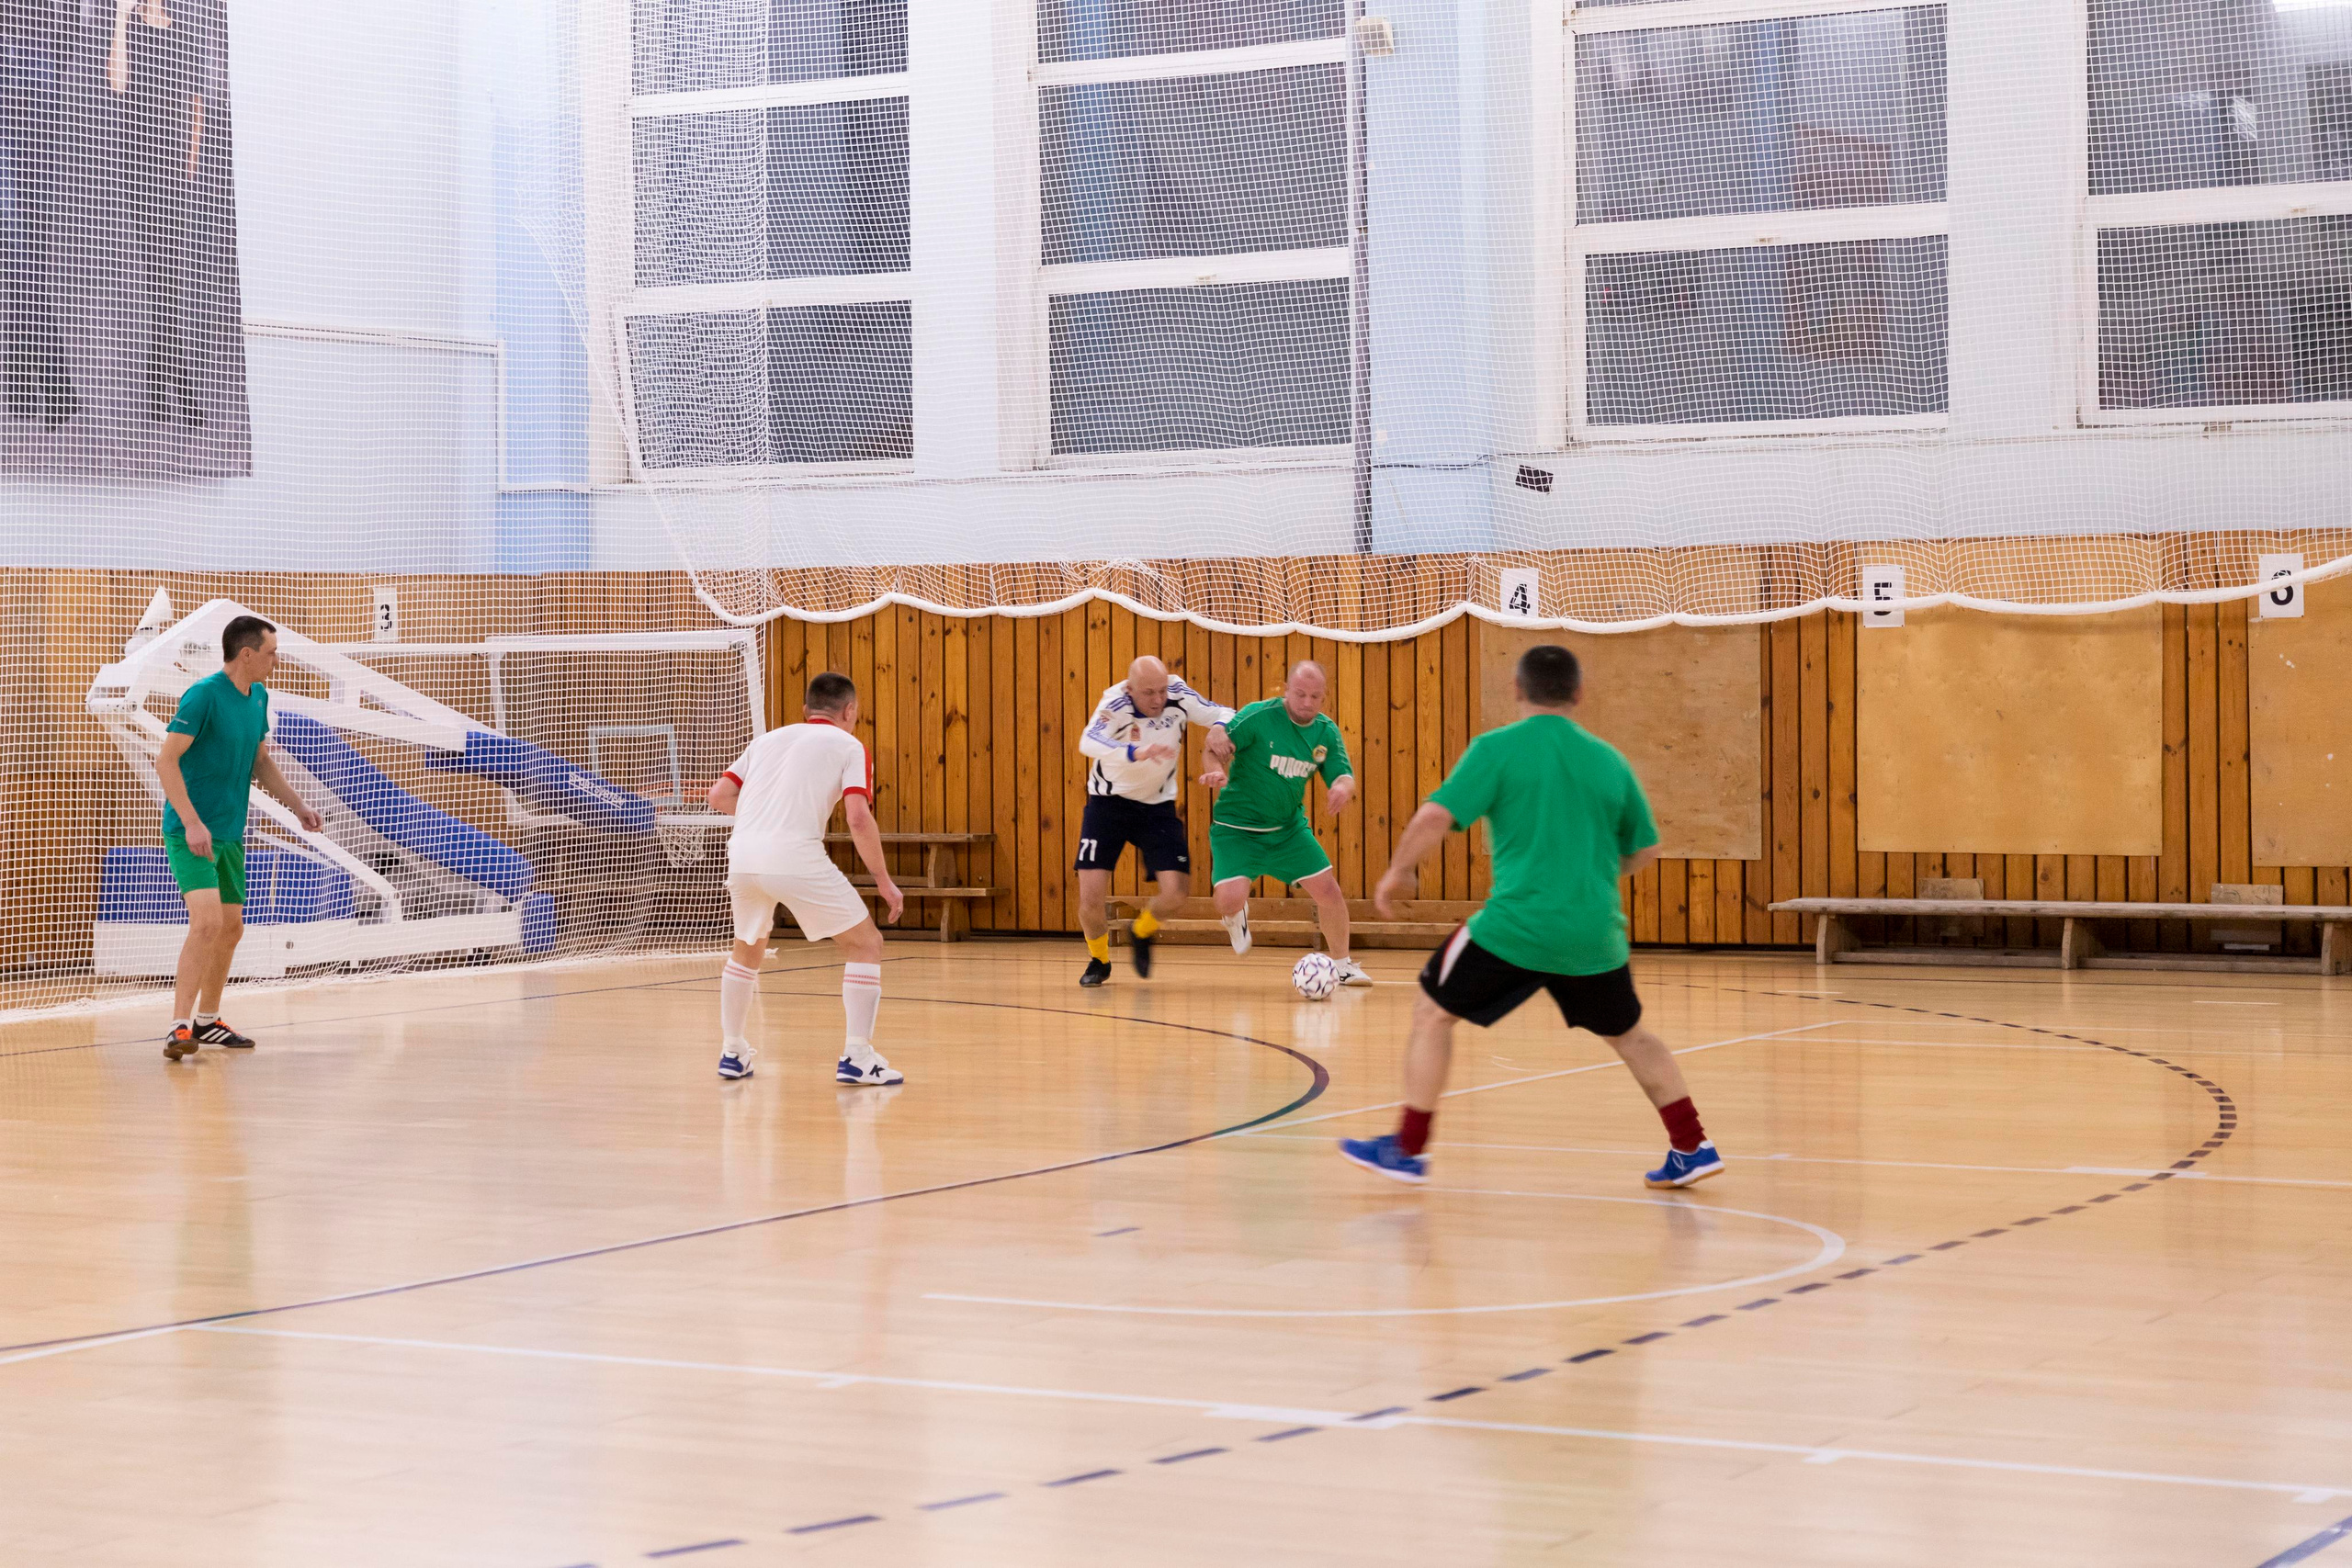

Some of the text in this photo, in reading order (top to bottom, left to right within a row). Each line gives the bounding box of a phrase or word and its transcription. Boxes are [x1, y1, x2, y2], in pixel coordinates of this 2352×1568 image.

[1509, 583, 1531, 615] 4
[1873, 581, 1893, 616] 5
[2270, 570, 2294, 606] 6
[379, 604, 392, 632] 3
[1078, 838, 1098, 862] 71
